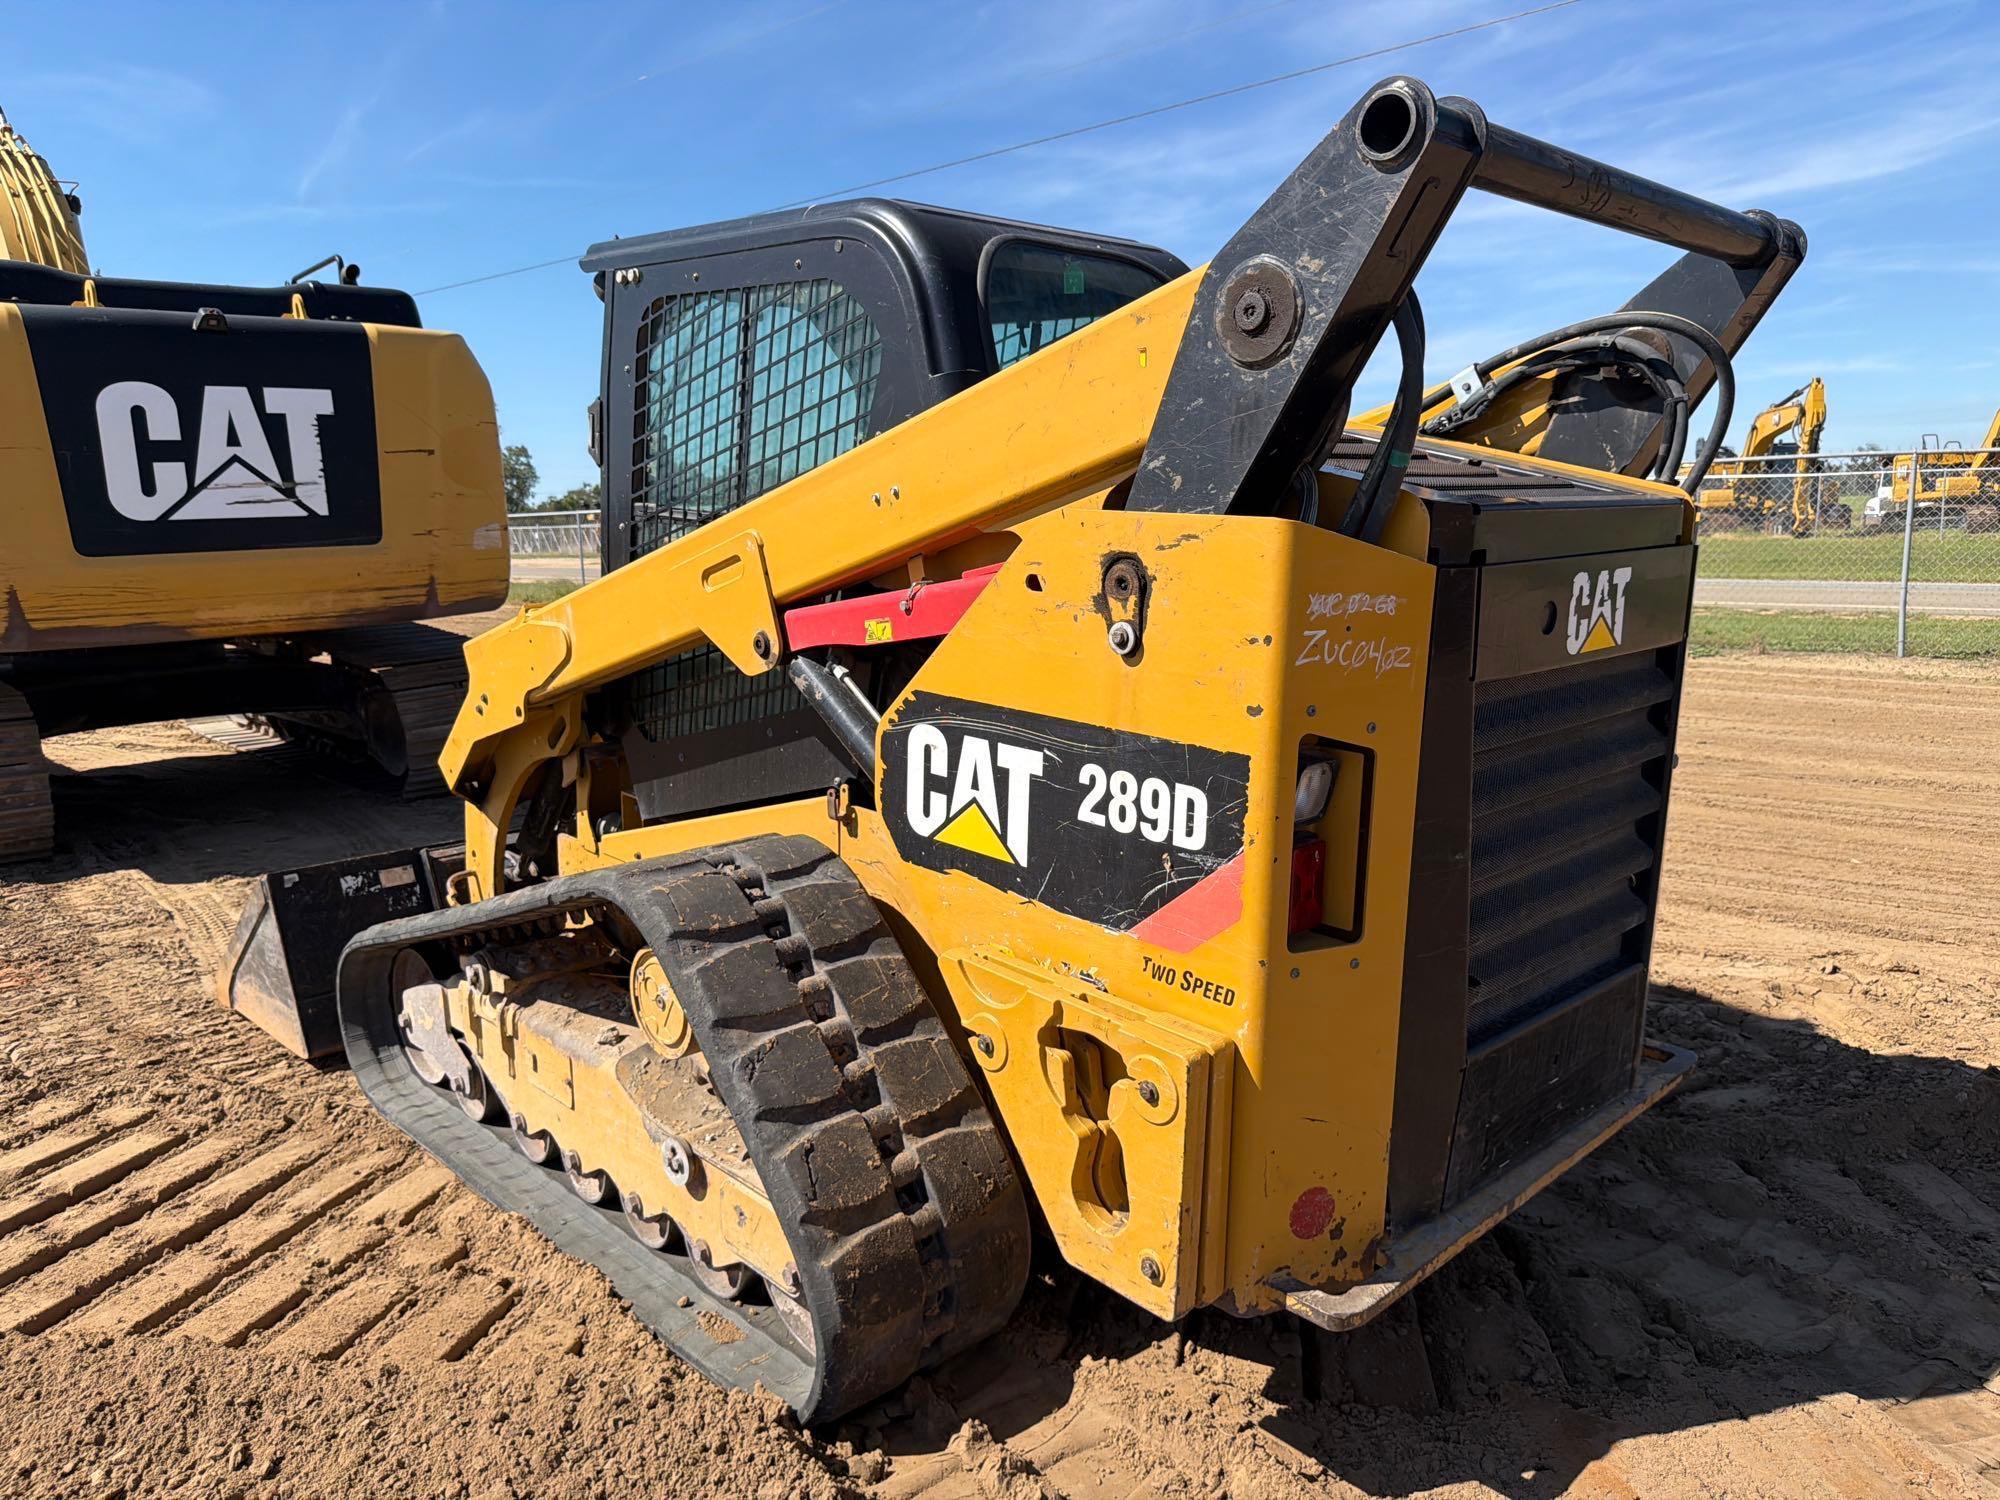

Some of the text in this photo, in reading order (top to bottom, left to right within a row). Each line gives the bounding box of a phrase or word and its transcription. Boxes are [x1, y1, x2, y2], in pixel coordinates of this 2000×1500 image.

[95, 380, 335, 521] CAT
[1566, 566, 1632, 655] CAT
[906, 723, 1208, 868] CAT 289D
[1180, 970, 1235, 1006] SPEED
